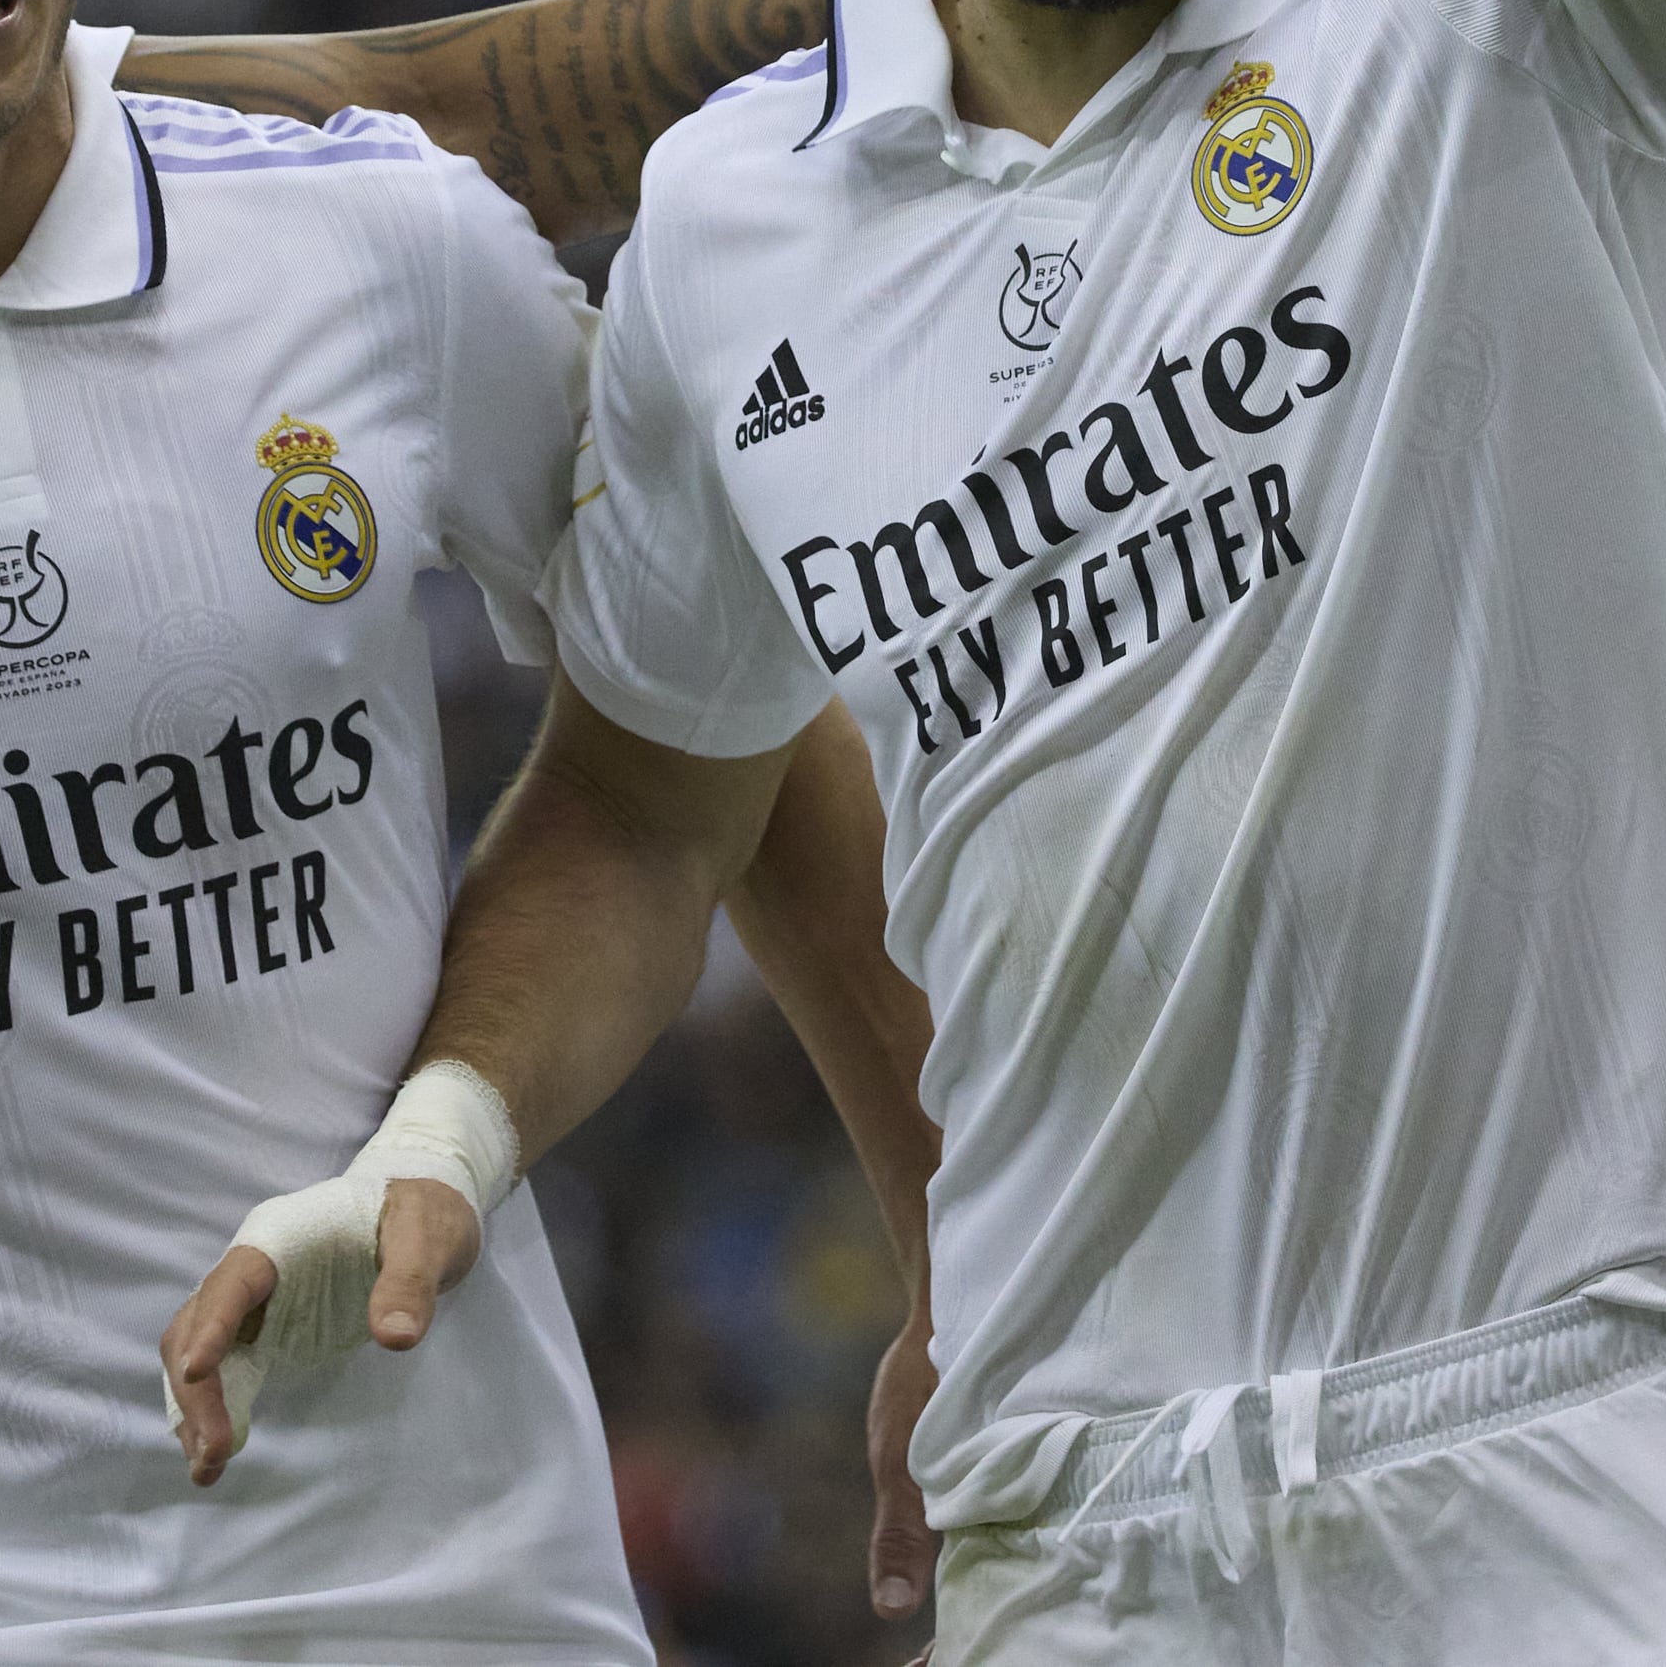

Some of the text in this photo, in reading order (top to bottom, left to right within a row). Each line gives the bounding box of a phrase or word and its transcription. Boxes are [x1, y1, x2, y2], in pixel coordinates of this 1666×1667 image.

[735, 391, 826, 451] adidas
[781, 285, 1352, 675] Emirates
[46, 678, 82, 692] 2023
[894, 463, 1306, 755] FLY BETTER
[58, 849, 336, 1017] BETTER
